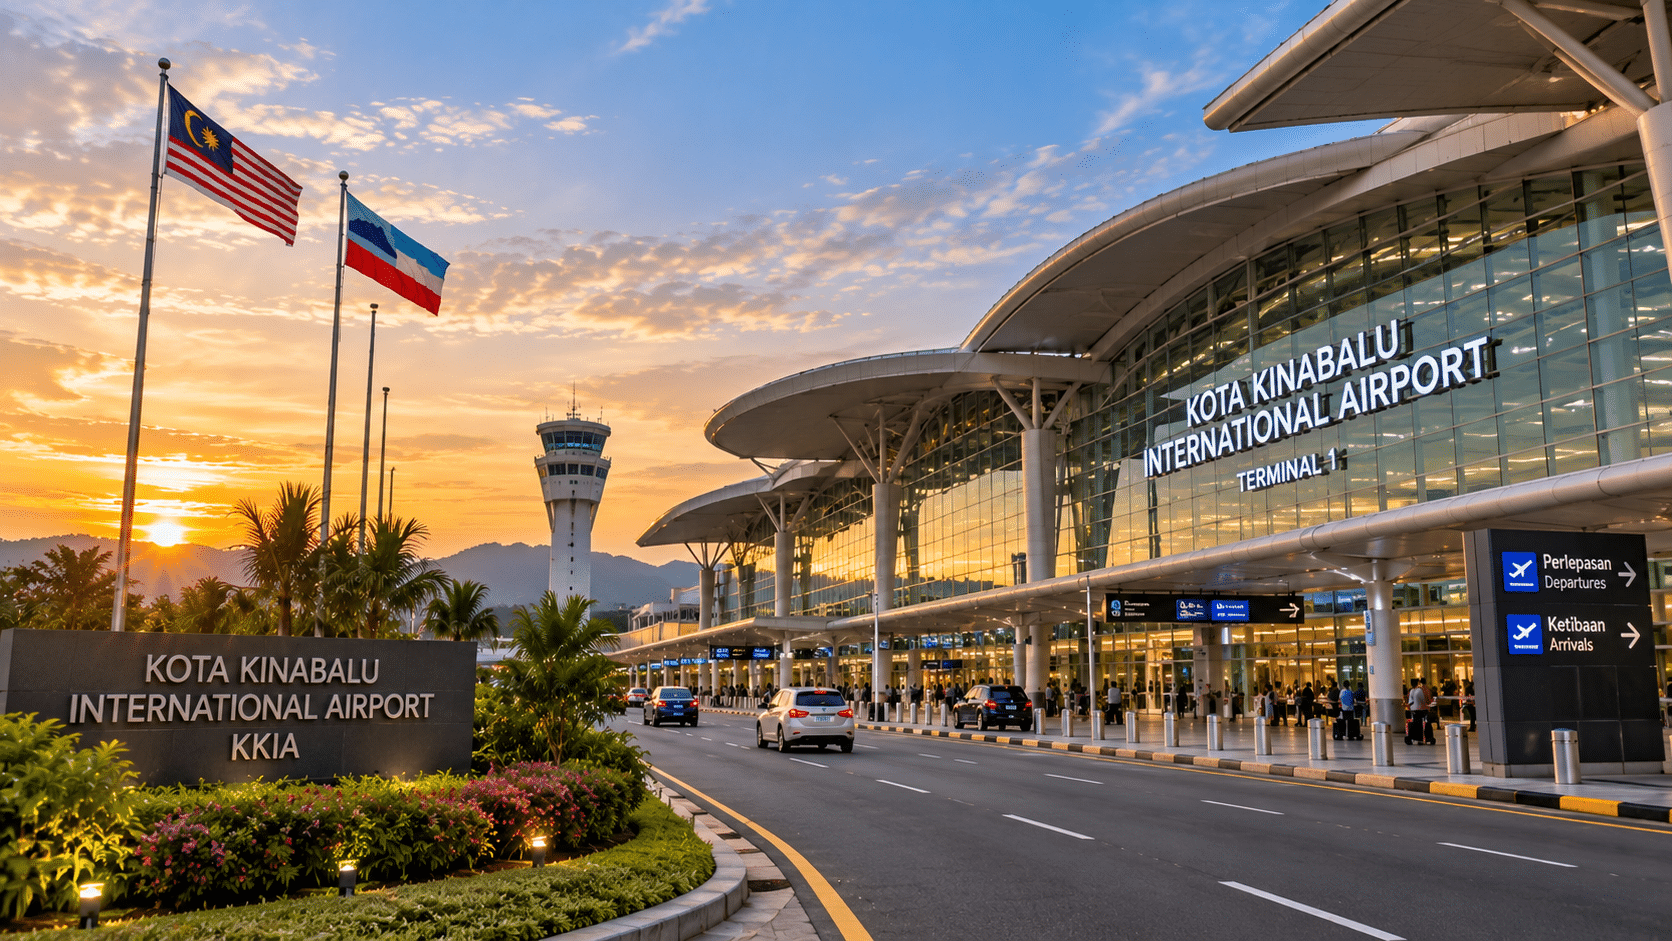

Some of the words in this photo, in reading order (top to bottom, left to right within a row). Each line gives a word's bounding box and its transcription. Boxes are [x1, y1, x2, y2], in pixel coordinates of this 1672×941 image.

[1187, 379, 1245, 427] KOTA
[1252, 319, 1399, 404] KINABALU
[1144, 392, 1329, 478] INTERNATIONAL
[1338, 336, 1490, 420] AIRPORT
[1237, 453, 1322, 492] TERMINAL
[1328, 448, 1337, 471] 1
[1543, 553, 1612, 573] Perlepasan
[1545, 575, 1607, 591] Departures
[1548, 616, 1606, 633] Ketibaan
[1550, 637, 1594, 651] Arrivals
[145, 654, 229, 683] KOTA
[239, 656, 380, 684] KINABALU
[69, 693, 318, 724] INTERNATIONAL
[324, 692, 435, 719] AIRPORT
[231, 732, 300, 761] KKIA
